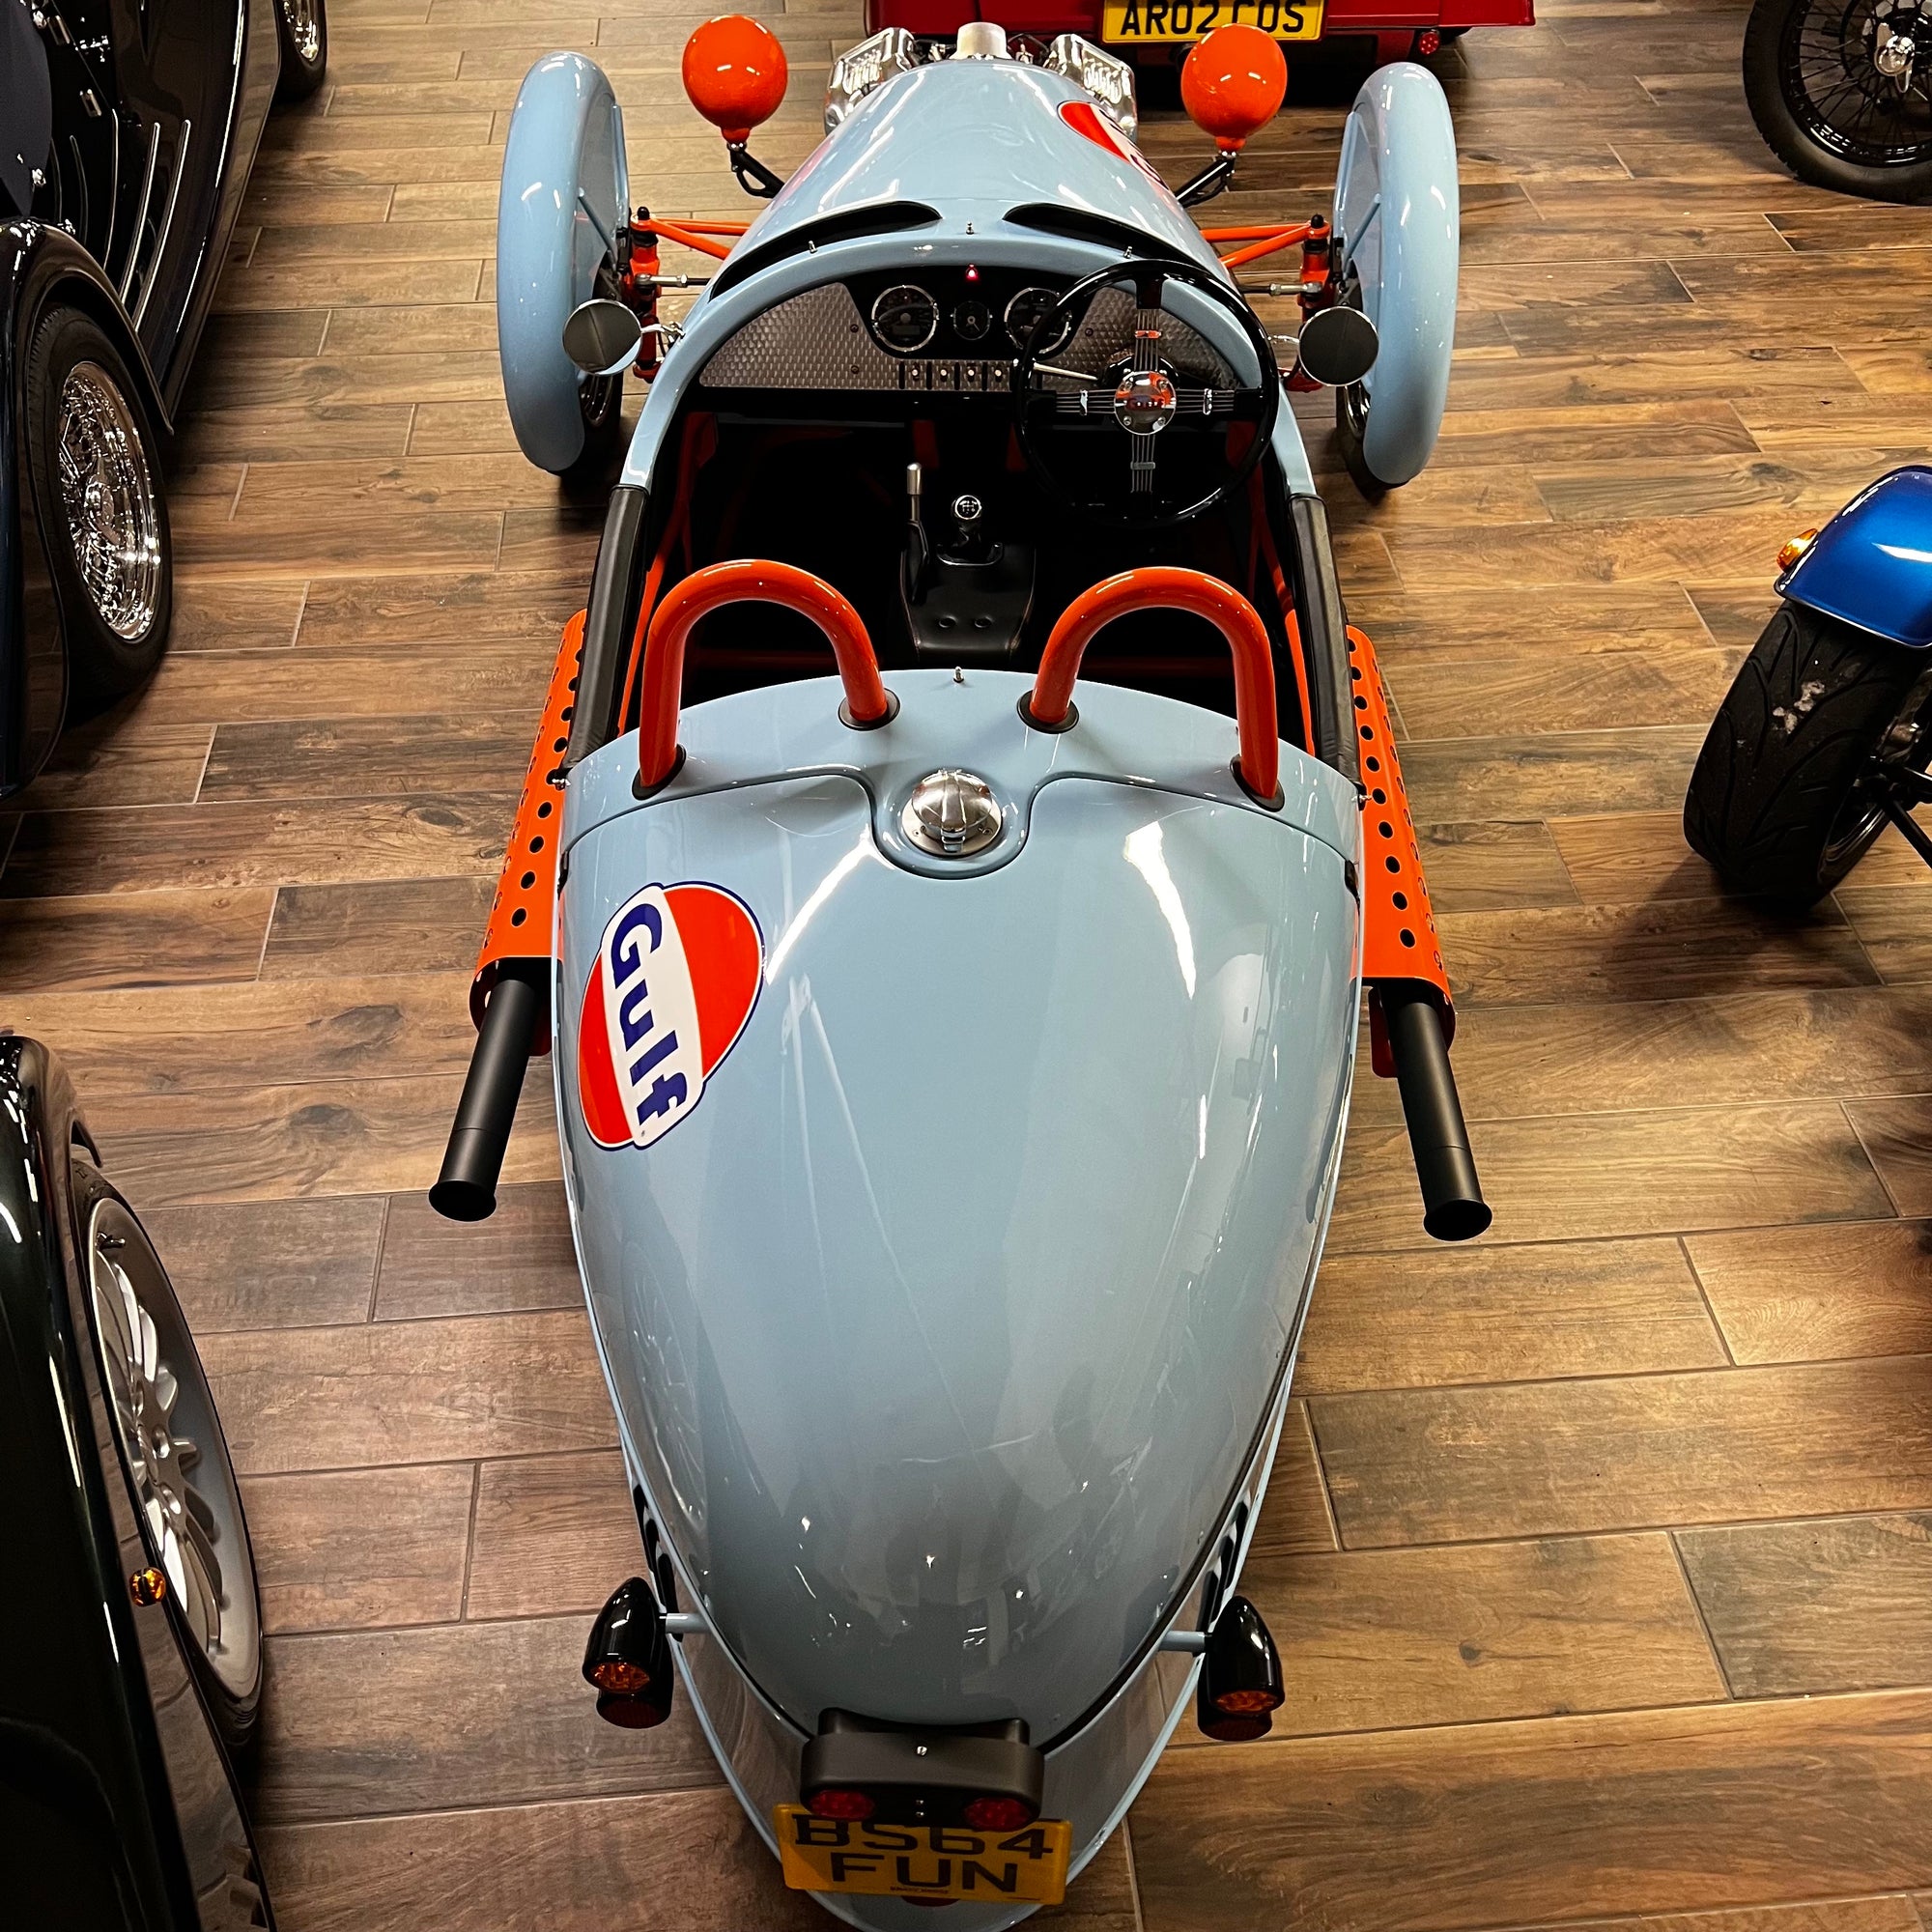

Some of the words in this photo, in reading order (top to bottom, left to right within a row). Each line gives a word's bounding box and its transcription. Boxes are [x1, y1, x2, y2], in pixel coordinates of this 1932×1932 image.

[1120, 0, 1220, 36] AR02
[610, 902, 688, 1126] Gulf
[791, 1813, 1054, 1860] BS64
[829, 1852, 1018, 1893] FUN
